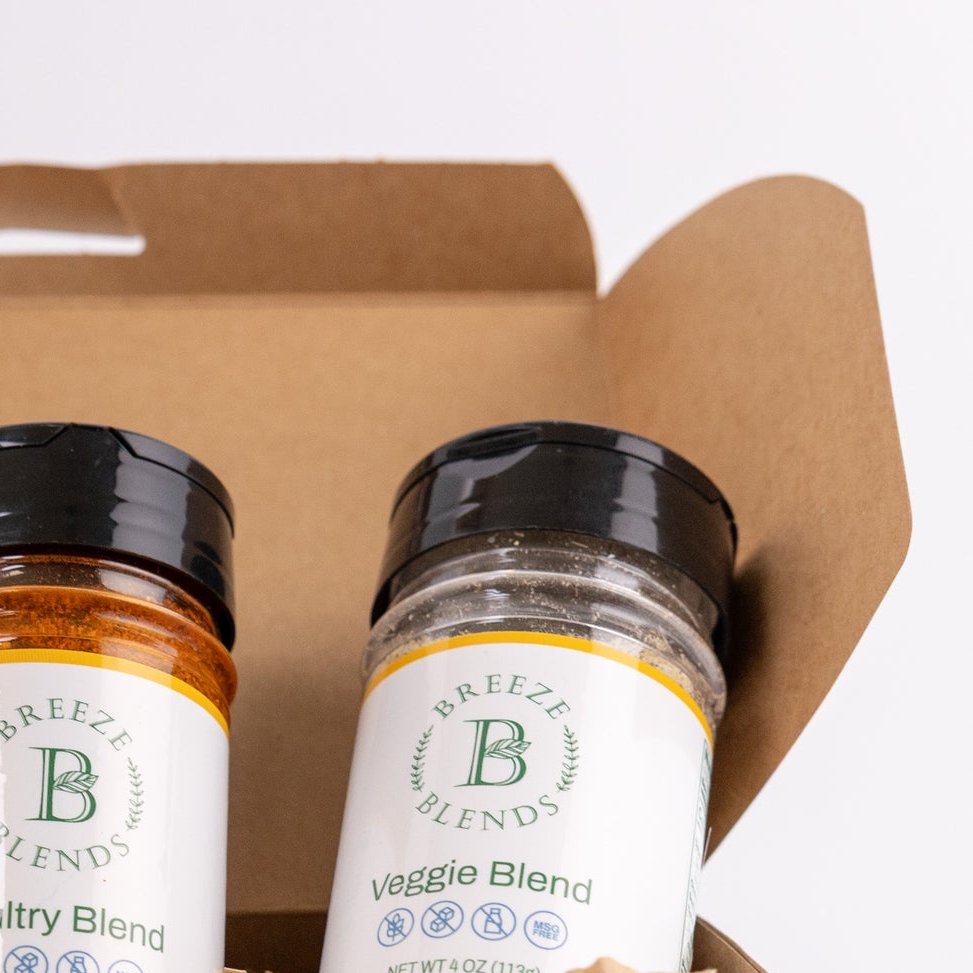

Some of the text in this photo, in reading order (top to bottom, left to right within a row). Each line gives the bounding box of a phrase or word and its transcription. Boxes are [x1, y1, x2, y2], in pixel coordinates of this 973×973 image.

[432, 674, 571, 721] BREEZE
[453, 719, 531, 788] B
[24, 746, 100, 823] B
[415, 790, 559, 831] BLENDS
[371, 859, 594, 906] Veggie Blend
[73, 905, 166, 953] Blend
[532, 929, 559, 942] FREE
[533, 920, 560, 934] MSG
[421, 958, 447, 973] WT
[449, 958, 459, 972] 4
[462, 958, 487, 973] OZ
